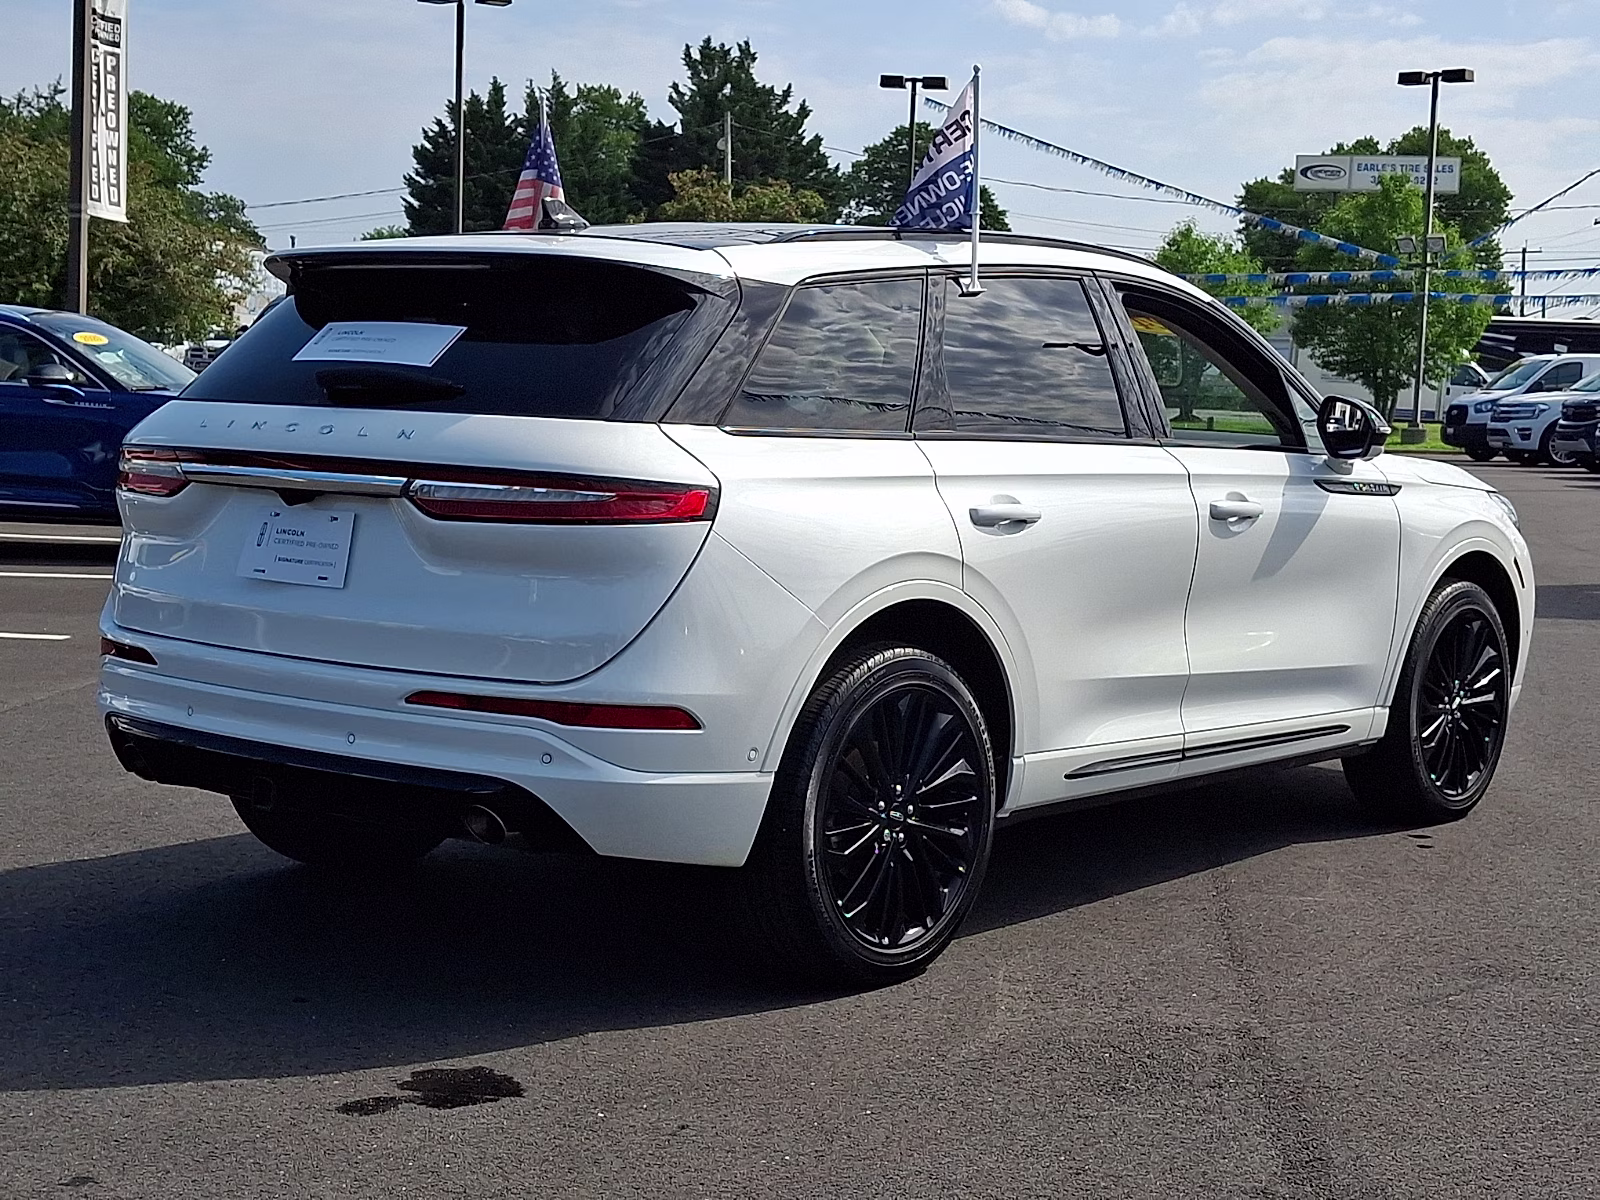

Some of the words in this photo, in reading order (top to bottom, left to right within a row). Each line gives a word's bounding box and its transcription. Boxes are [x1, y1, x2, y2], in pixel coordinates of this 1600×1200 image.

[91, 48, 100, 199] CERTIFIED
[106, 54, 119, 203] PREOWNED
[1356, 162, 1397, 173] EARLE'S
[1399, 164, 1421, 174] TIRE
[1423, 164, 1455, 174] SLES
[200, 418, 416, 440] LINCOLN
[275, 528, 306, 537] LINCOLN
[274, 537, 305, 547] CERTIFIED
